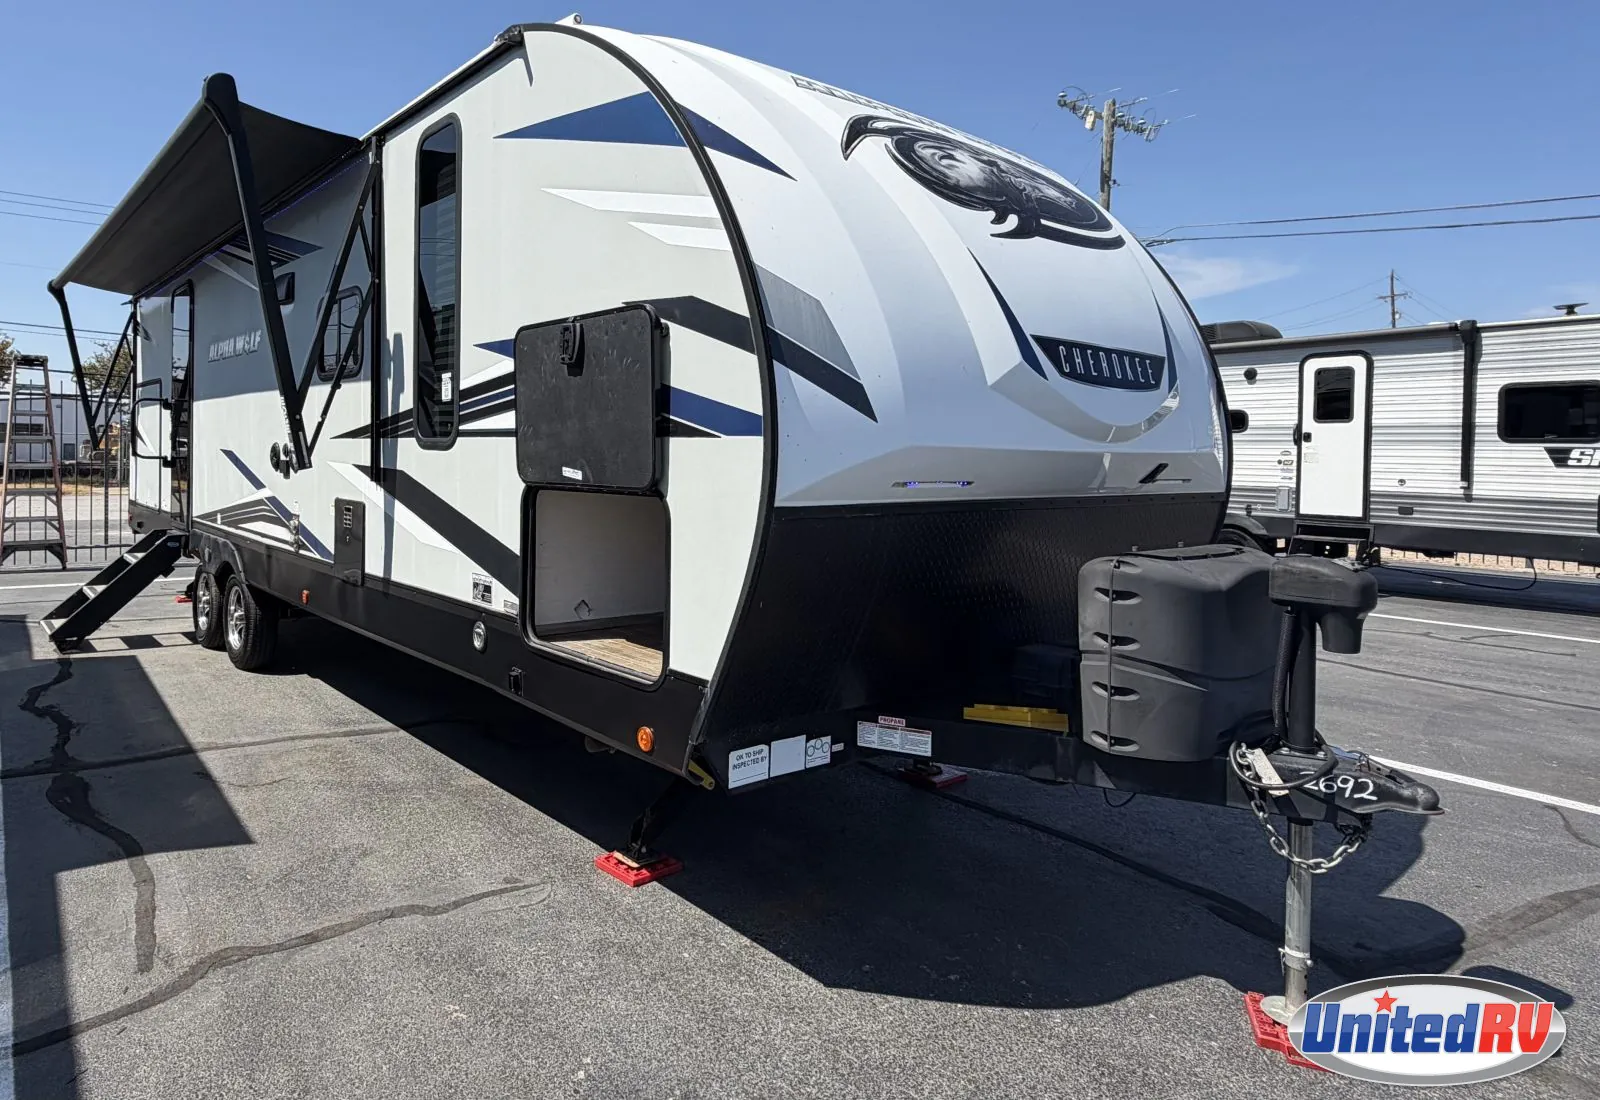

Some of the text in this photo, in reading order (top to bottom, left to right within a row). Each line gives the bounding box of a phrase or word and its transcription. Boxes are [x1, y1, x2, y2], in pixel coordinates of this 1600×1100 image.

[1058, 345, 1156, 384] CHEROKEE
[879, 716, 904, 726] PROPANE
[735, 748, 764, 761] OK TO SHIP
[732, 755, 767, 770] INSPECTED BY
